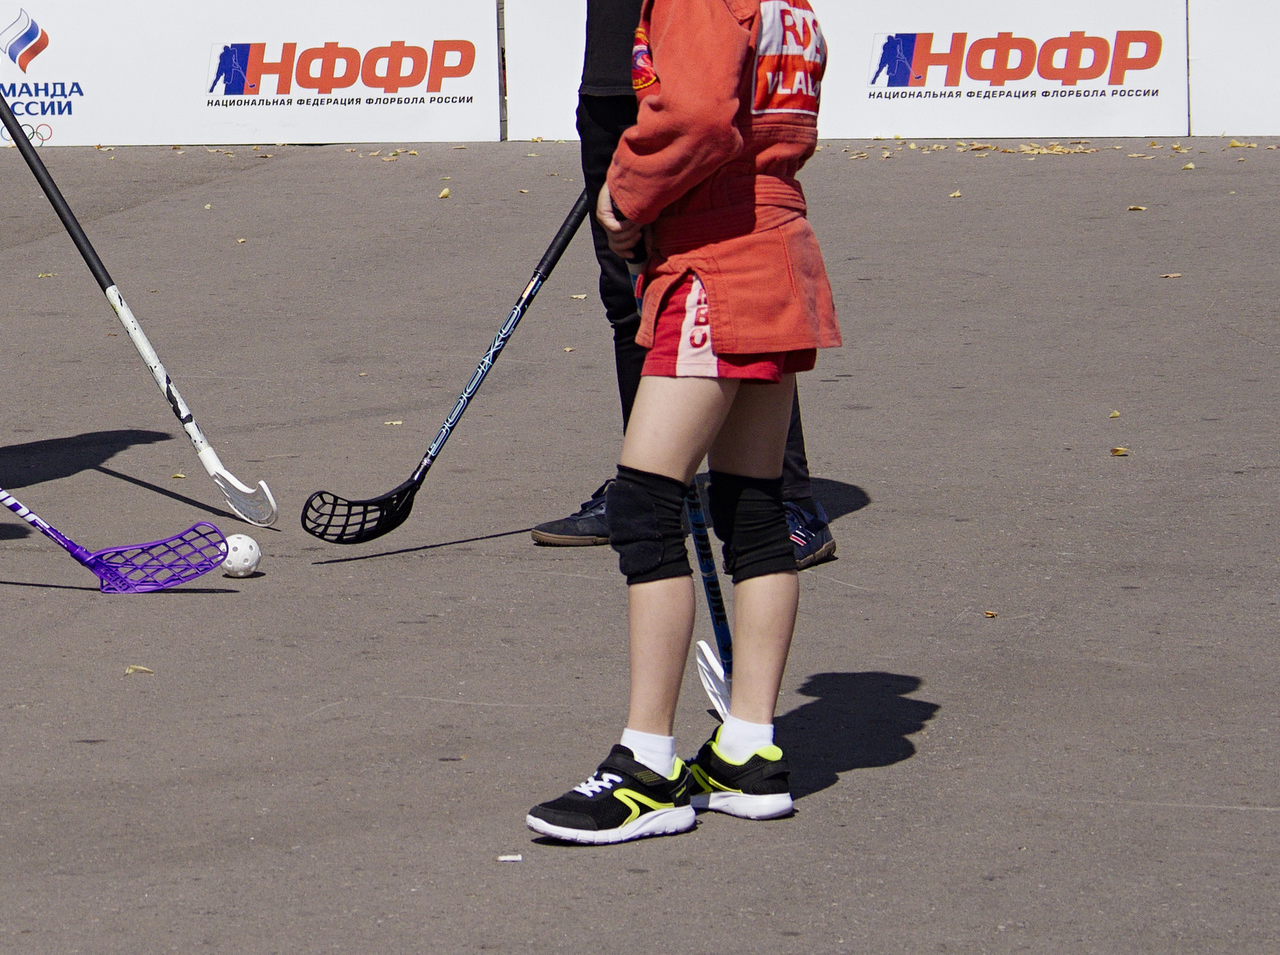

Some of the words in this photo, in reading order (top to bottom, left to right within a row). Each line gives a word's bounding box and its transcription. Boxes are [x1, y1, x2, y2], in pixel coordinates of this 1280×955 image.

[242, 39, 476, 95] НФФР
[908, 29, 1163, 88] НФФР
[207, 98, 293, 108] НАЦИОНАЛЬНАЯ
[296, 97, 361, 107] ФЕДЕРАЦИЯ
[365, 96, 426, 106] ФЛОРБОЛА
[429, 95, 474, 105] РОССИИ
[868, 90, 962, 100] НАЦИОНАЛЬНАЯ
[966, 89, 1037, 100] ФЕДЕРАЦИЯ
[1041, 89, 1107, 99] ФЛОРБОЛА
[1111, 88, 1160, 97] РОССИИ
